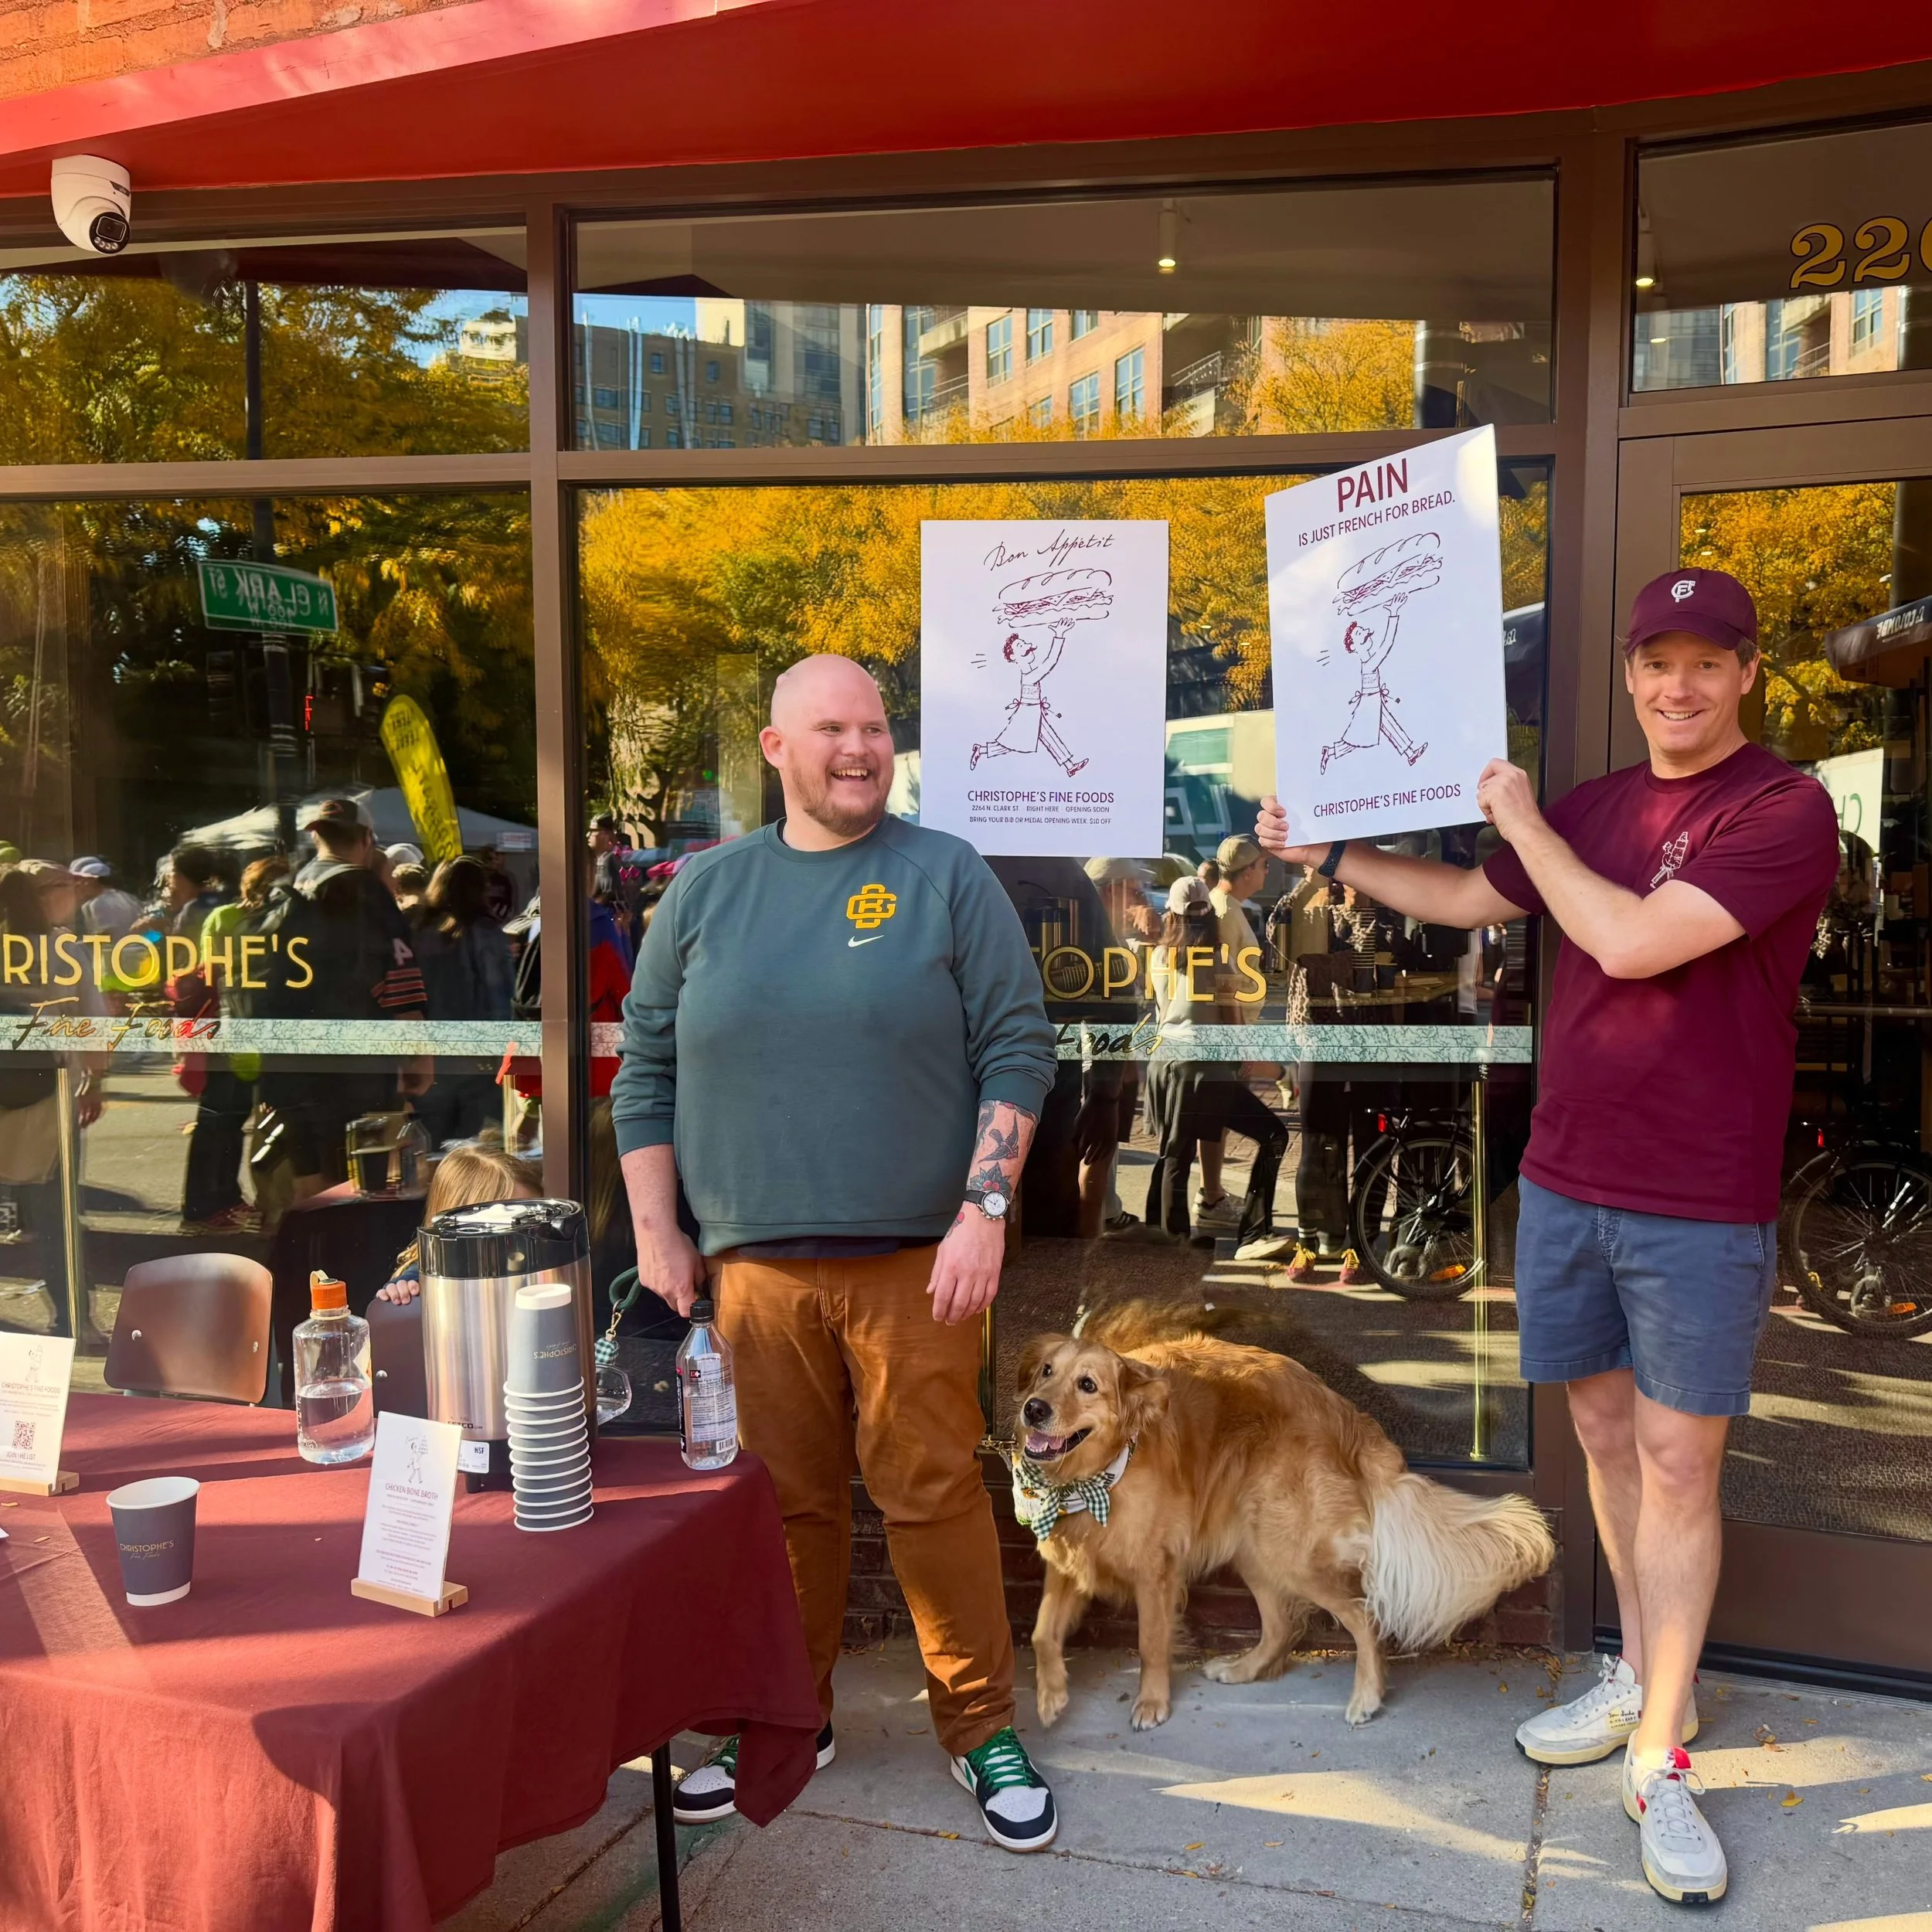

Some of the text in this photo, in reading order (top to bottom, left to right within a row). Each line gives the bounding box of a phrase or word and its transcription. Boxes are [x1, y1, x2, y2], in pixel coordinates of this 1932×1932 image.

[1789, 216, 1932, 290] 22
[1337, 457, 1408, 513] PAIN
[1298, 490, 1456, 546] IS JUST FRENCH FOR BREAD.
[984, 541, 1028, 571] Bon
[968, 790, 1114, 803] CHRISTOPHE'S FINE FOODS
[1314, 784, 1461, 818] CHRISTOPHE'S FINE FOODS
[2, 932, 315, 990] RISTOPHE'S
[1029, 943, 1268, 1003] OPHE'S
[12, 996, 222, 1052] Fine Foods
[385, 1482, 406, 1495] CHICKEN
[406, 1486, 420, 1497] BONE
[420, 1489, 438, 1501] BROTH
[119, 1539, 175, 1553] CHRISTOPHE'S
